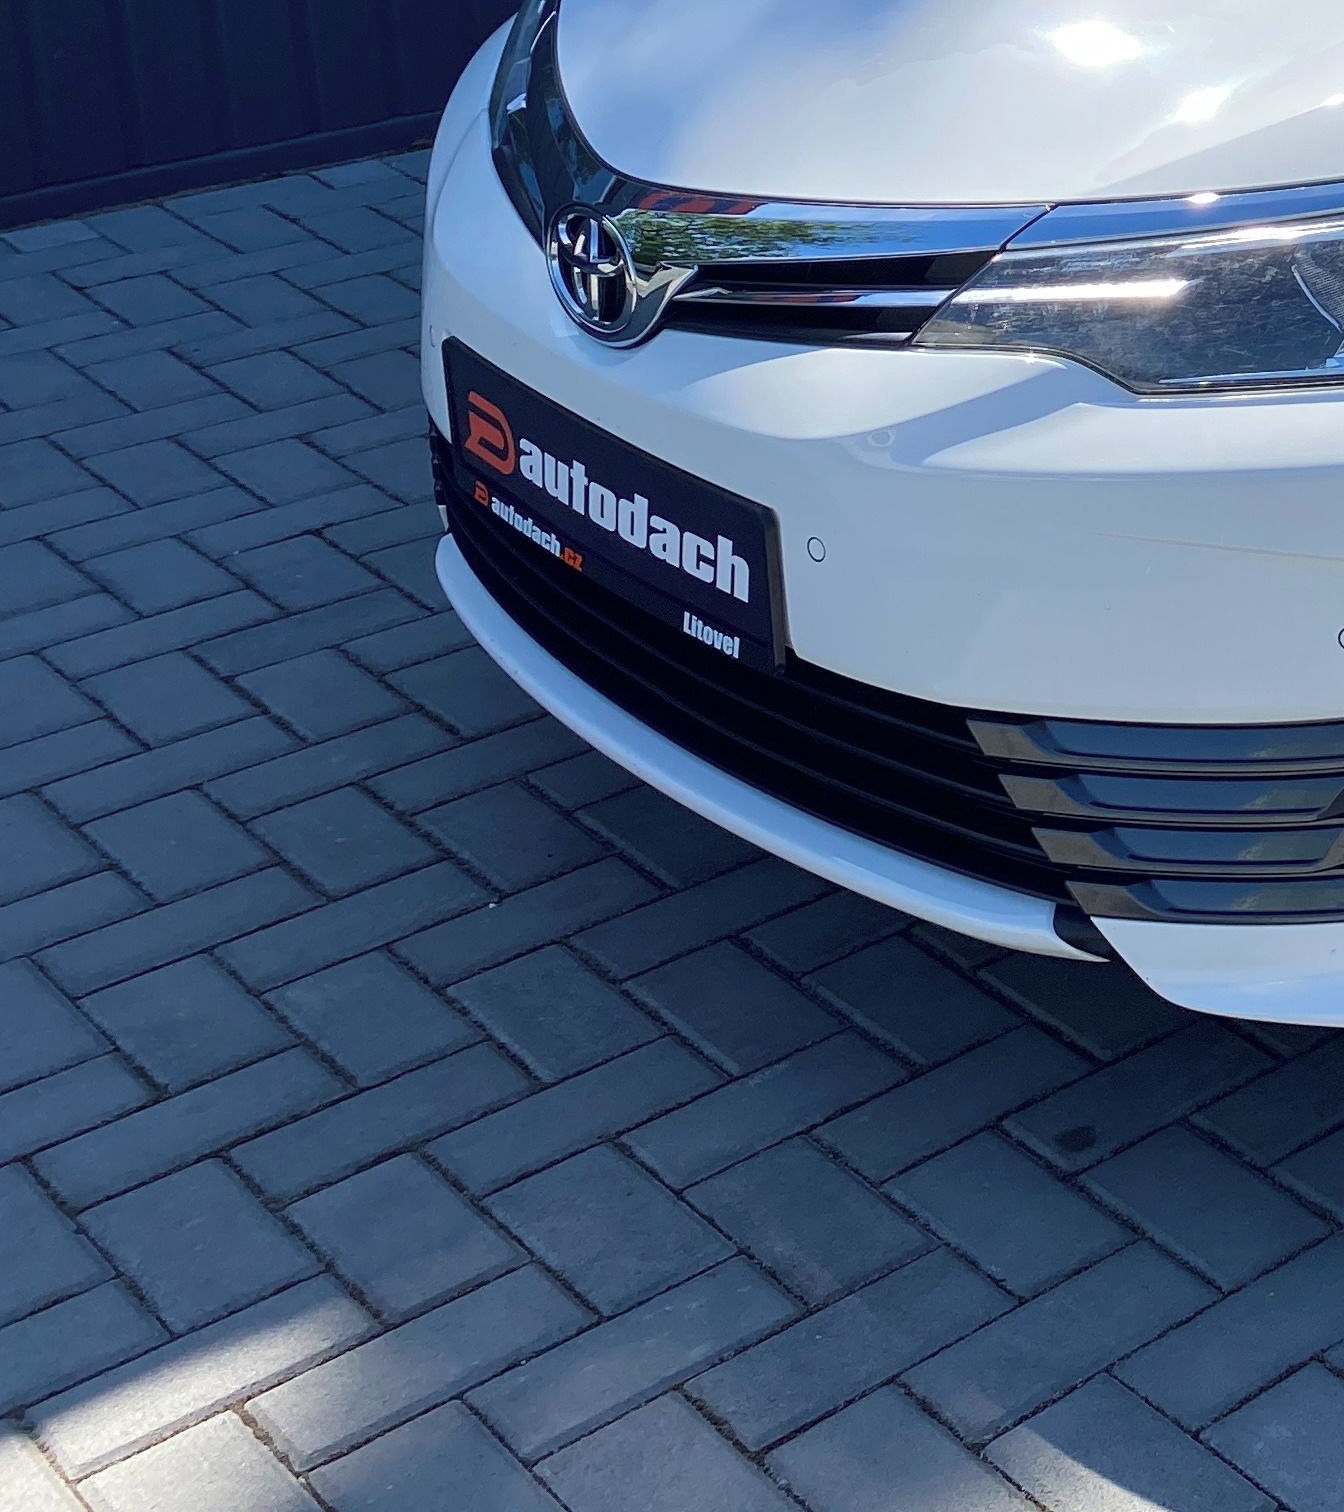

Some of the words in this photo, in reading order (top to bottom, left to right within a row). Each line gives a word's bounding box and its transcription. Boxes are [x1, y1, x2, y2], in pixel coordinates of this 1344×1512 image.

[491, 496, 583, 573] autodach.cz
[519, 437, 749, 603] autodach
[683, 610, 740, 659] Litovel
